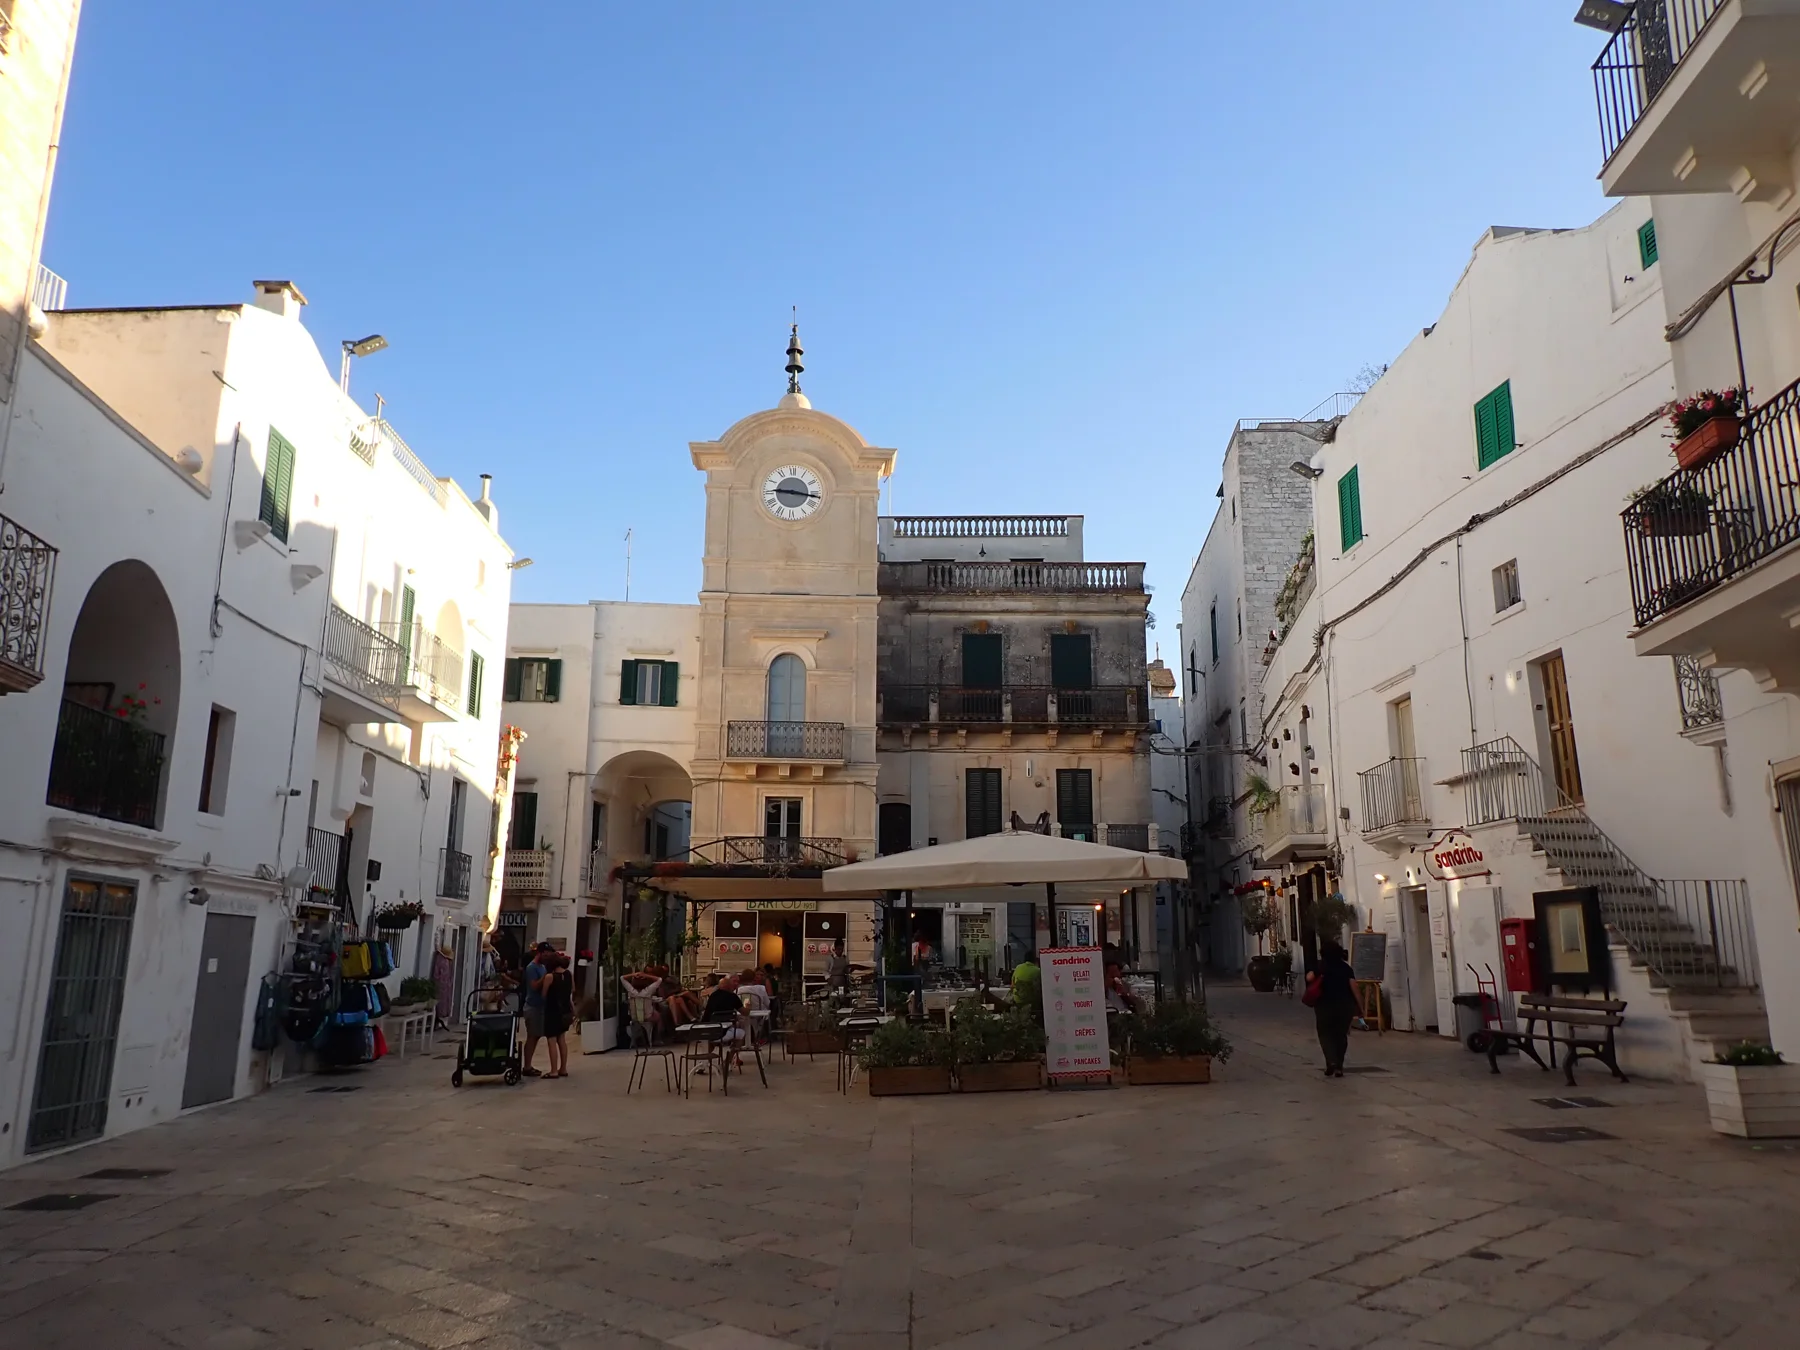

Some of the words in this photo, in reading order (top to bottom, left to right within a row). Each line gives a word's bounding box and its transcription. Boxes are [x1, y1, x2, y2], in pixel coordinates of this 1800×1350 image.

[499, 913, 526, 925] TOCK
[1052, 955, 1091, 966] sandrino
[1072, 970, 1091, 978] GELATI
[1073, 1000, 1093, 1008] YOGURT
[1073, 1057, 1101, 1066] PANCAKES
